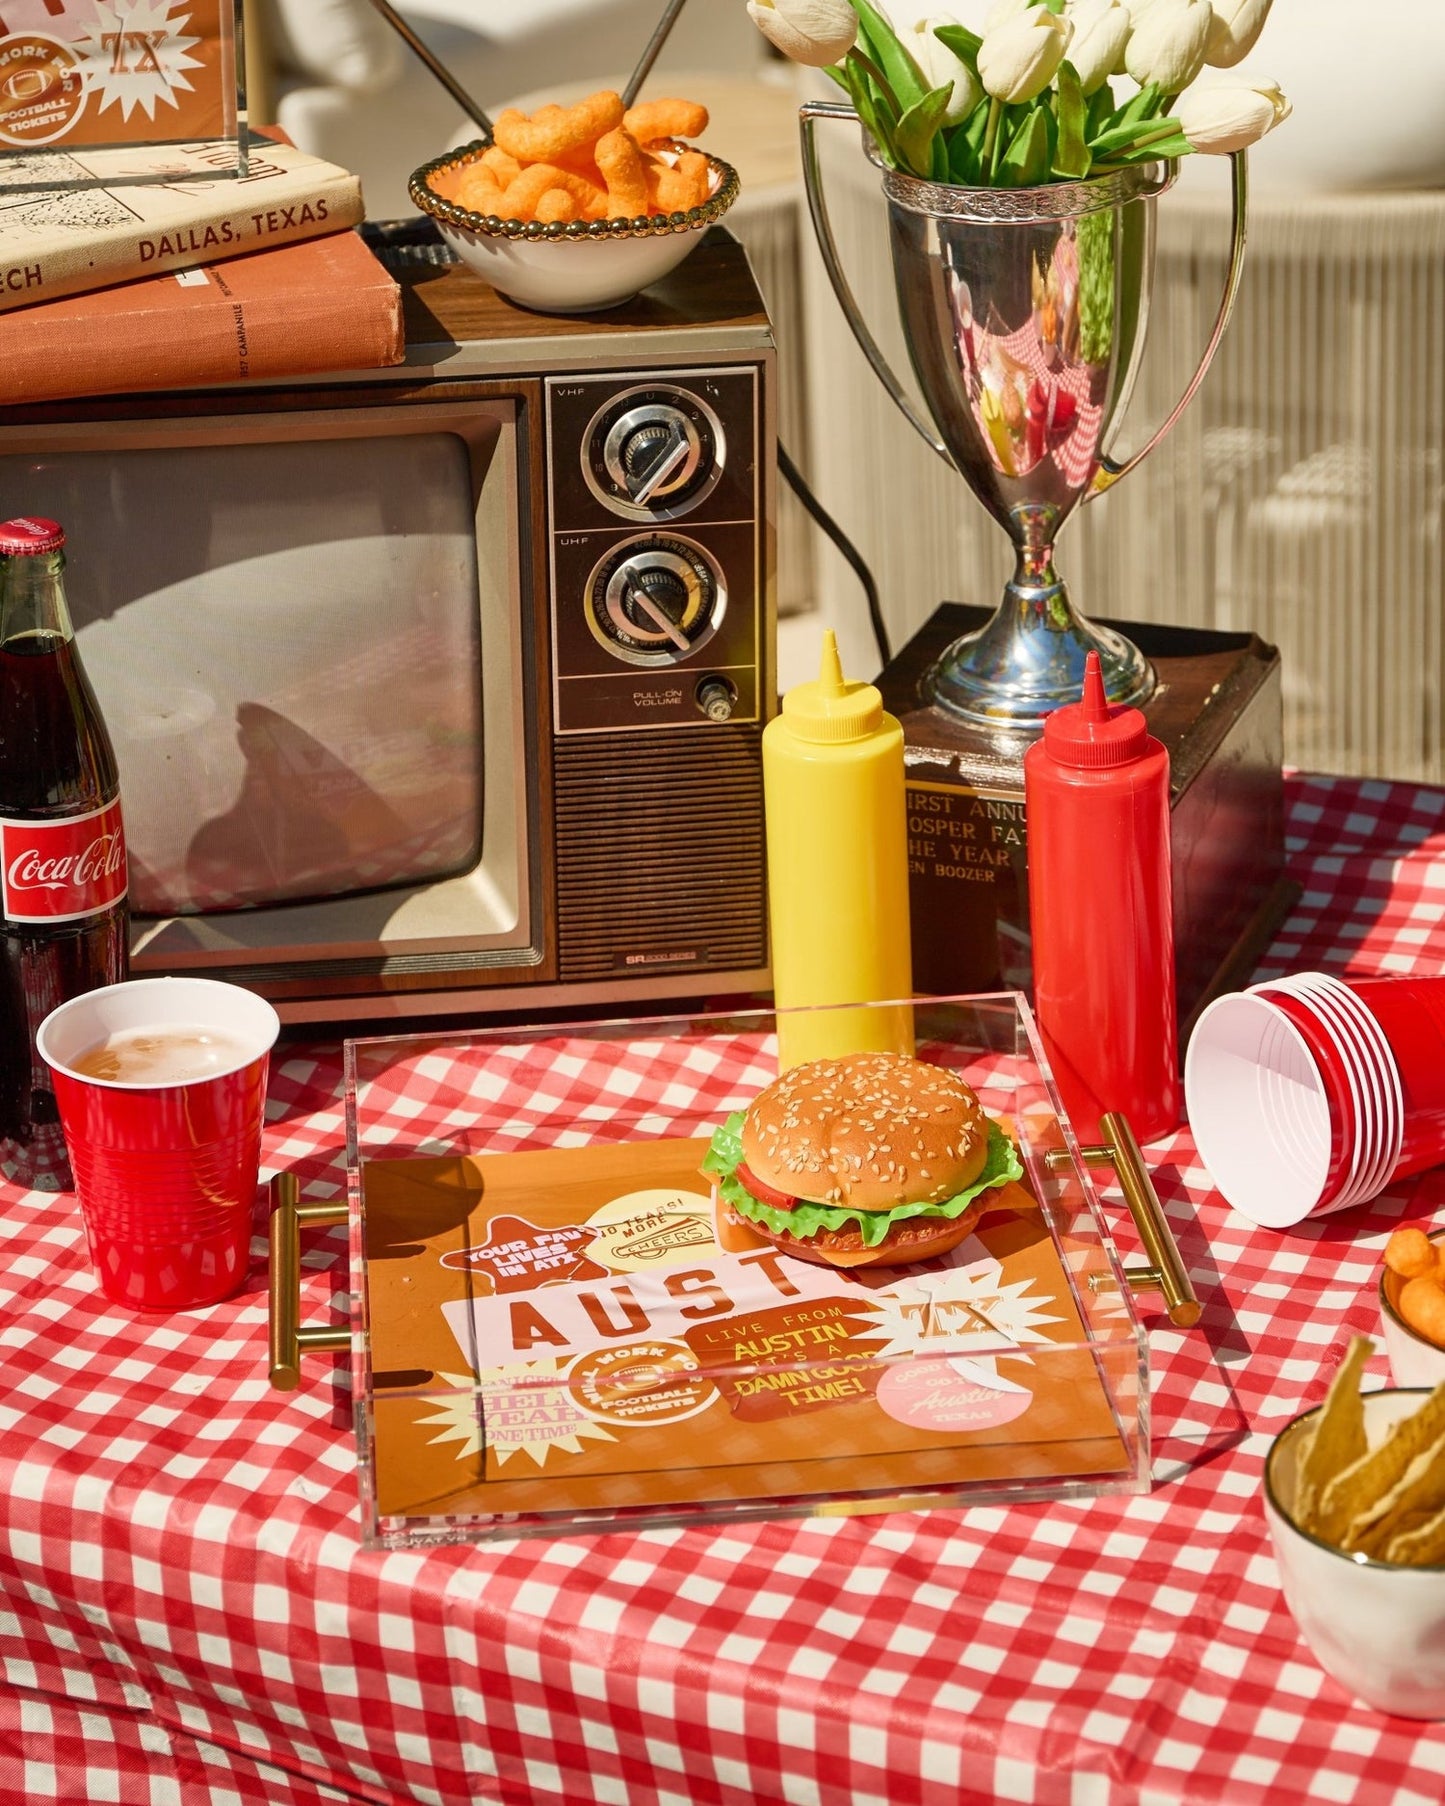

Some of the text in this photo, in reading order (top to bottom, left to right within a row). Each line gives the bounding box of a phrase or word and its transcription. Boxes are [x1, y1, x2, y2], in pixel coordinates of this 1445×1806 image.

[101, 31, 170, 75] TX
[8, 111, 68, 132] TICKETS
[139, 221, 241, 262] DALLAS,
[252, 199, 329, 236] TEXAS
[232, 303, 248, 357] CAMPANILE
[557, 388, 585, 397] VHF
[691, 411, 700, 420] 3
[700, 433, 708, 443] 4
[560, 537, 590, 546] UHF
[633, 689, 682, 700] PULL-ON
[633, 697, 682, 708] VOLUME
[907, 792, 1027, 822] IRST ANNU
[909, 817, 977, 839] OSPER
[908, 838, 1010, 867] HE YEAR
[935, 863, 996, 883] BOOZER
[622, 1215, 668, 1238] MORE
[467, 1240, 529, 1263] YOUR
[628, 1227, 703, 1253] CHEERS
[491, 1243, 569, 1268] LIVES
[496, 1253, 578, 1277] IN ATX
[510, 1252, 947, 1350] AUST
[705, 1307, 843, 1343] LIVE FROM
[899, 1295, 1005, 1339] TX
[734, 1322, 850, 1361] AUSTIN
[828, 1344, 842, 1355] A
[595, 1347, 667, 1365] WORK
[733, 1351, 887, 1397] DAMN GOOD
[601, 1387, 702, 1410] FOOTBALL
[779, 1377, 867, 1406] TIME!
[908, 1387, 1006, 1416] Austin
[468, 1407, 589, 1429] YEAH
[614, 1397, 697, 1417] TICKETS
[485, 1424, 577, 1442] ONE TIME
